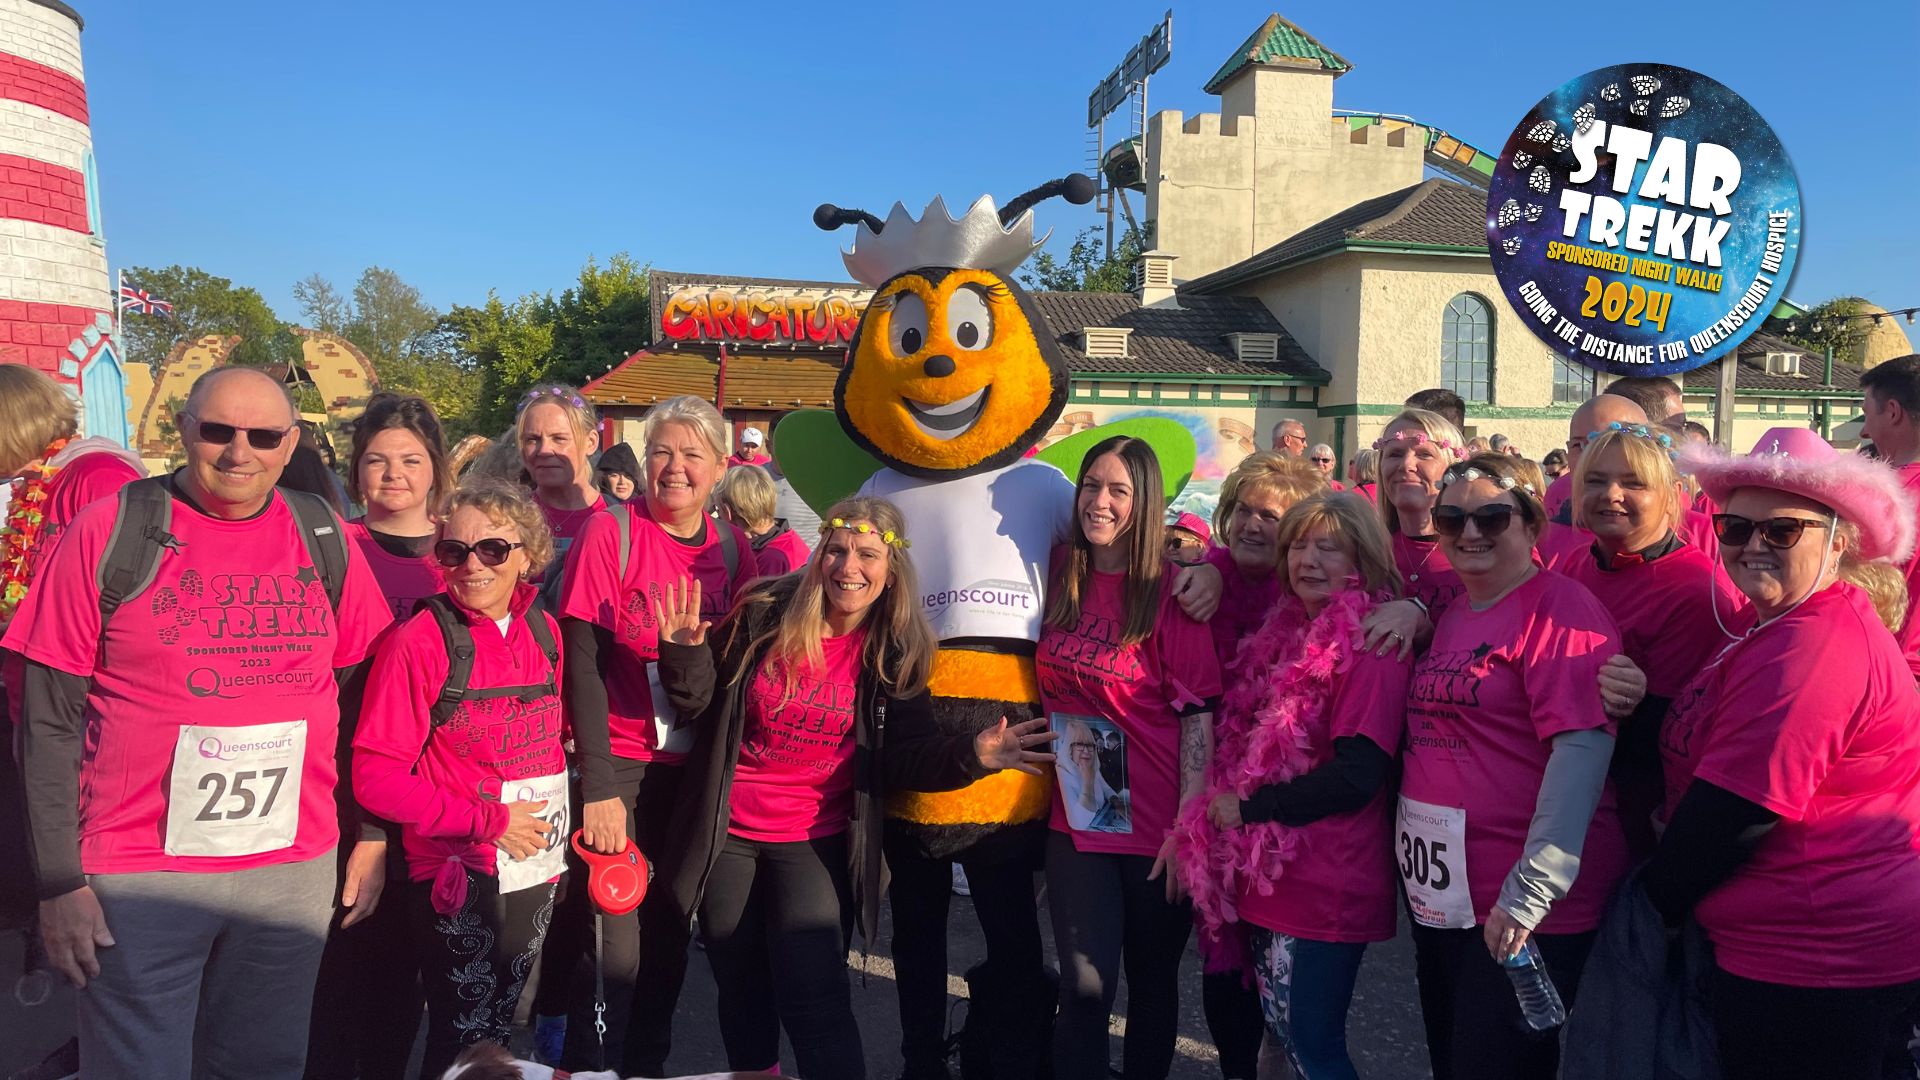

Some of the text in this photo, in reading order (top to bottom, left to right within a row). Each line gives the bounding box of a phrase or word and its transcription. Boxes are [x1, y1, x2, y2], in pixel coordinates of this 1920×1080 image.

[210, 574, 307, 606] STAR
[921, 589, 1029, 609] eenscourt
[199, 606, 329, 639] TREKK
[239, 658, 271, 668] 2023
[186, 667, 314, 698] Queenscourt
[786, 676, 857, 714] TAR
[198, 736, 293, 761] Queenscourt
[746, 734, 835, 773] Queenscourt
[194, 766, 289, 822] 257
[1401, 831, 1451, 890] 305
